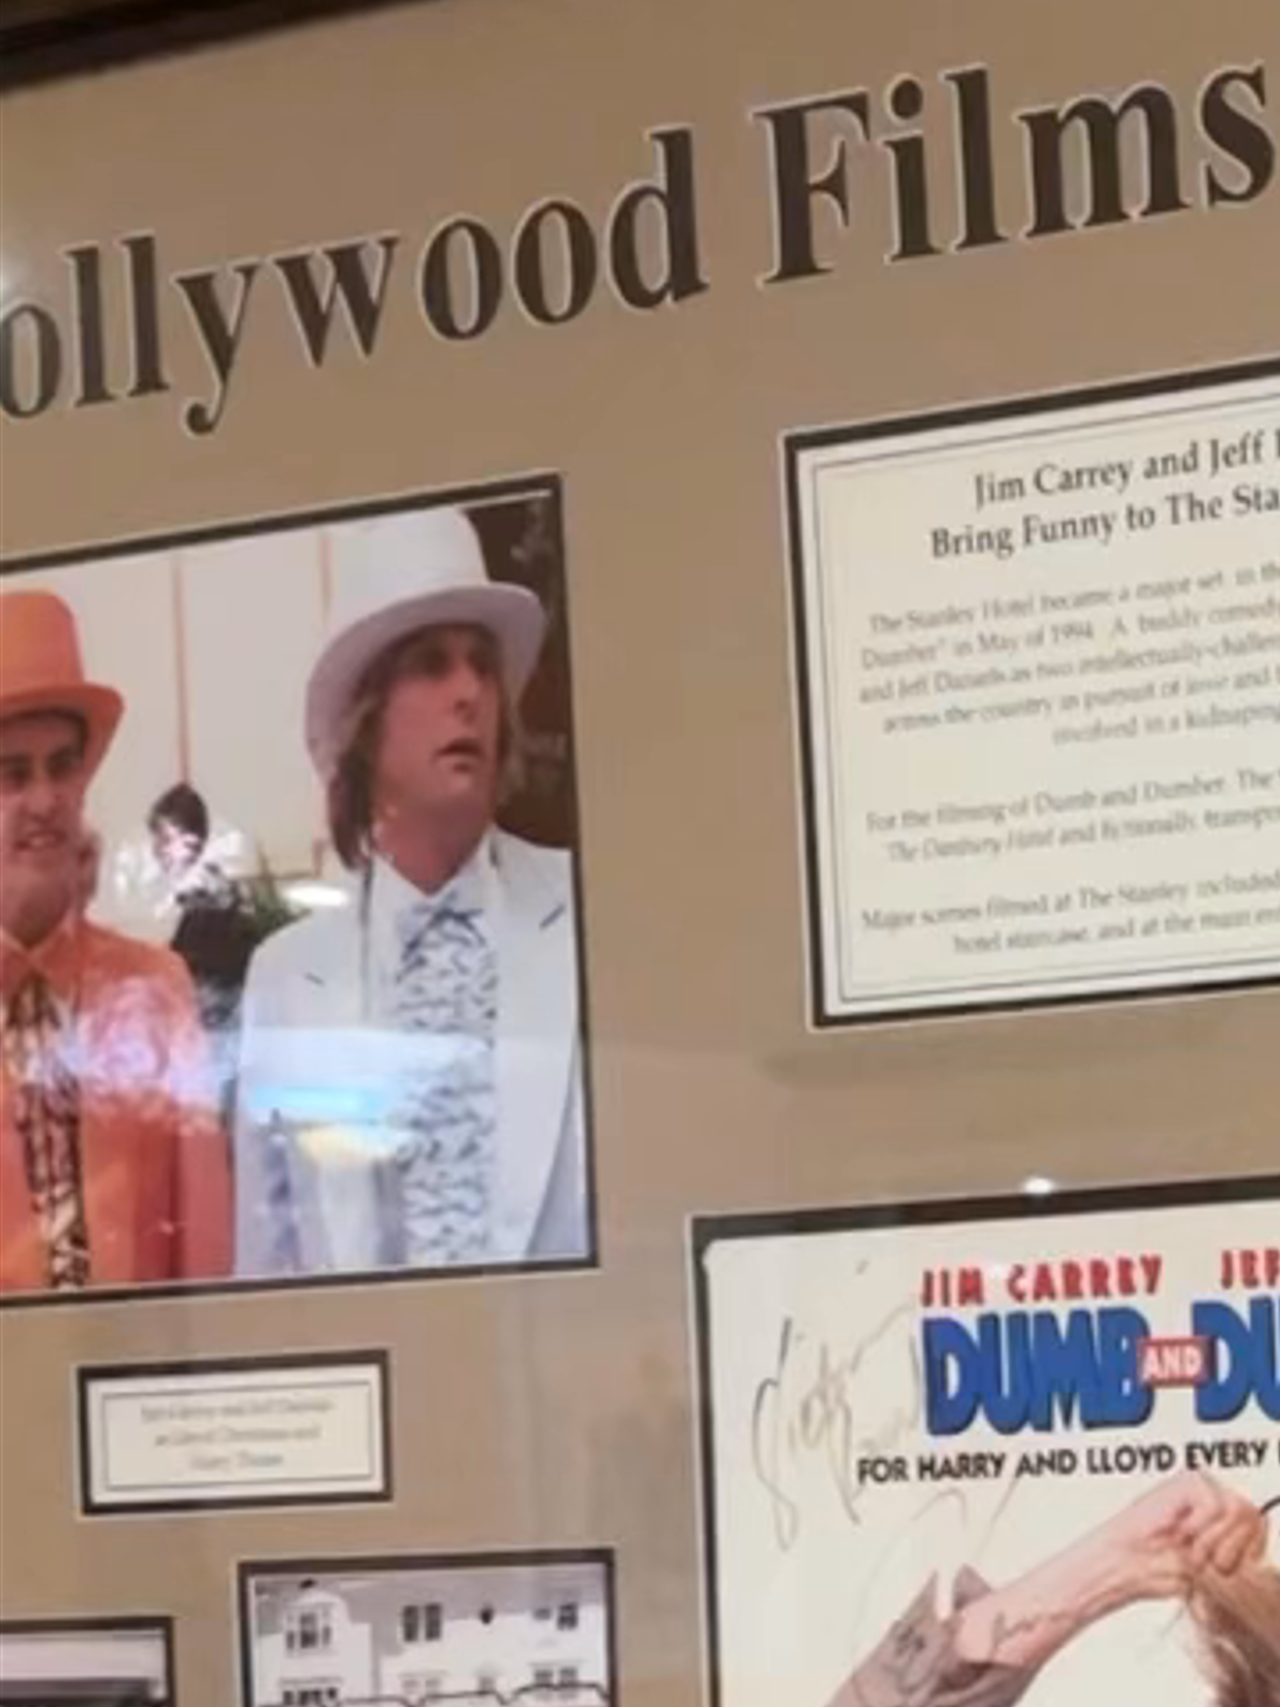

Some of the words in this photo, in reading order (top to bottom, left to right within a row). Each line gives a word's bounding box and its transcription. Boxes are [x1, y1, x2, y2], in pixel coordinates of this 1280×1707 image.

[750, 61, 1278, 287] Films
[974, 474, 1025, 509] Jim
[1033, 461, 1132, 495] Carrey
[1142, 440, 1199, 479] and
[1207, 429, 1265, 476] Jeff
[930, 524, 1014, 559] Bring
[1022, 512, 1115, 546] Funny
[1125, 503, 1155, 530] to
[1164, 491, 1223, 525] The
[869, 613, 902, 633] The
[904, 605, 974, 631] Stanley
[981, 595, 1034, 620] Hotel
[1039, 590, 1112, 612] became
[1117, 586, 1129, 602] a
[1135, 576, 1191, 600] major
[1235, 568, 1256, 586] in
[953, 640, 973, 657] in
[976, 631, 1018, 656] May
[1024, 624, 1046, 647] of
[1111, 616, 1128, 637] A
[1137, 606, 1200, 634] buddy
[858, 680, 893, 703] and
[898, 675, 929, 699] Jeff
[933, 666, 1008, 693] Daniels
[1009, 667, 1032, 683] as
[1035, 662, 1073, 679] two
[943, 704, 979, 723] the
[1060, 694, 1081, 710] in
[1083, 681, 1155, 711] pursuit
[1160, 679, 1181, 698] of
[1233, 664, 1271, 690] and
[1145, 716, 1165, 733] in
[1169, 715, 1180, 732] a
[865, 811, 896, 832] For
[900, 809, 931, 828] the
[1033, 790, 1097, 816] Dumb
[1100, 784, 1137, 808] and
[1236, 768, 1277, 790] The
[1058, 821, 1096, 846] and
[861, 909, 915, 931] Major
[986, 894, 1048, 917] filmed
[1054, 892, 1071, 913] at
[1078, 886, 1114, 909] The
[1117, 882, 1189, 904] Stanley
[952, 930, 1001, 952] hotel
[1097, 917, 1135, 940] and
[1140, 917, 1159, 937] at
[1163, 912, 1194, 933] the
[921, 1270, 986, 1307] JIM
[1007, 1255, 1165, 1302] CARREY
[921, 1305, 1156, 1436] DUMB
[1142, 1342, 1202, 1381] AND
[858, 1457, 908, 1485] FOR
[917, 1451, 1005, 1481] HARRY
[1014, 1448, 1078, 1476] AND
[1086, 1442, 1175, 1474] LLOYD
[1185, 1437, 1269, 1470] EVERY
